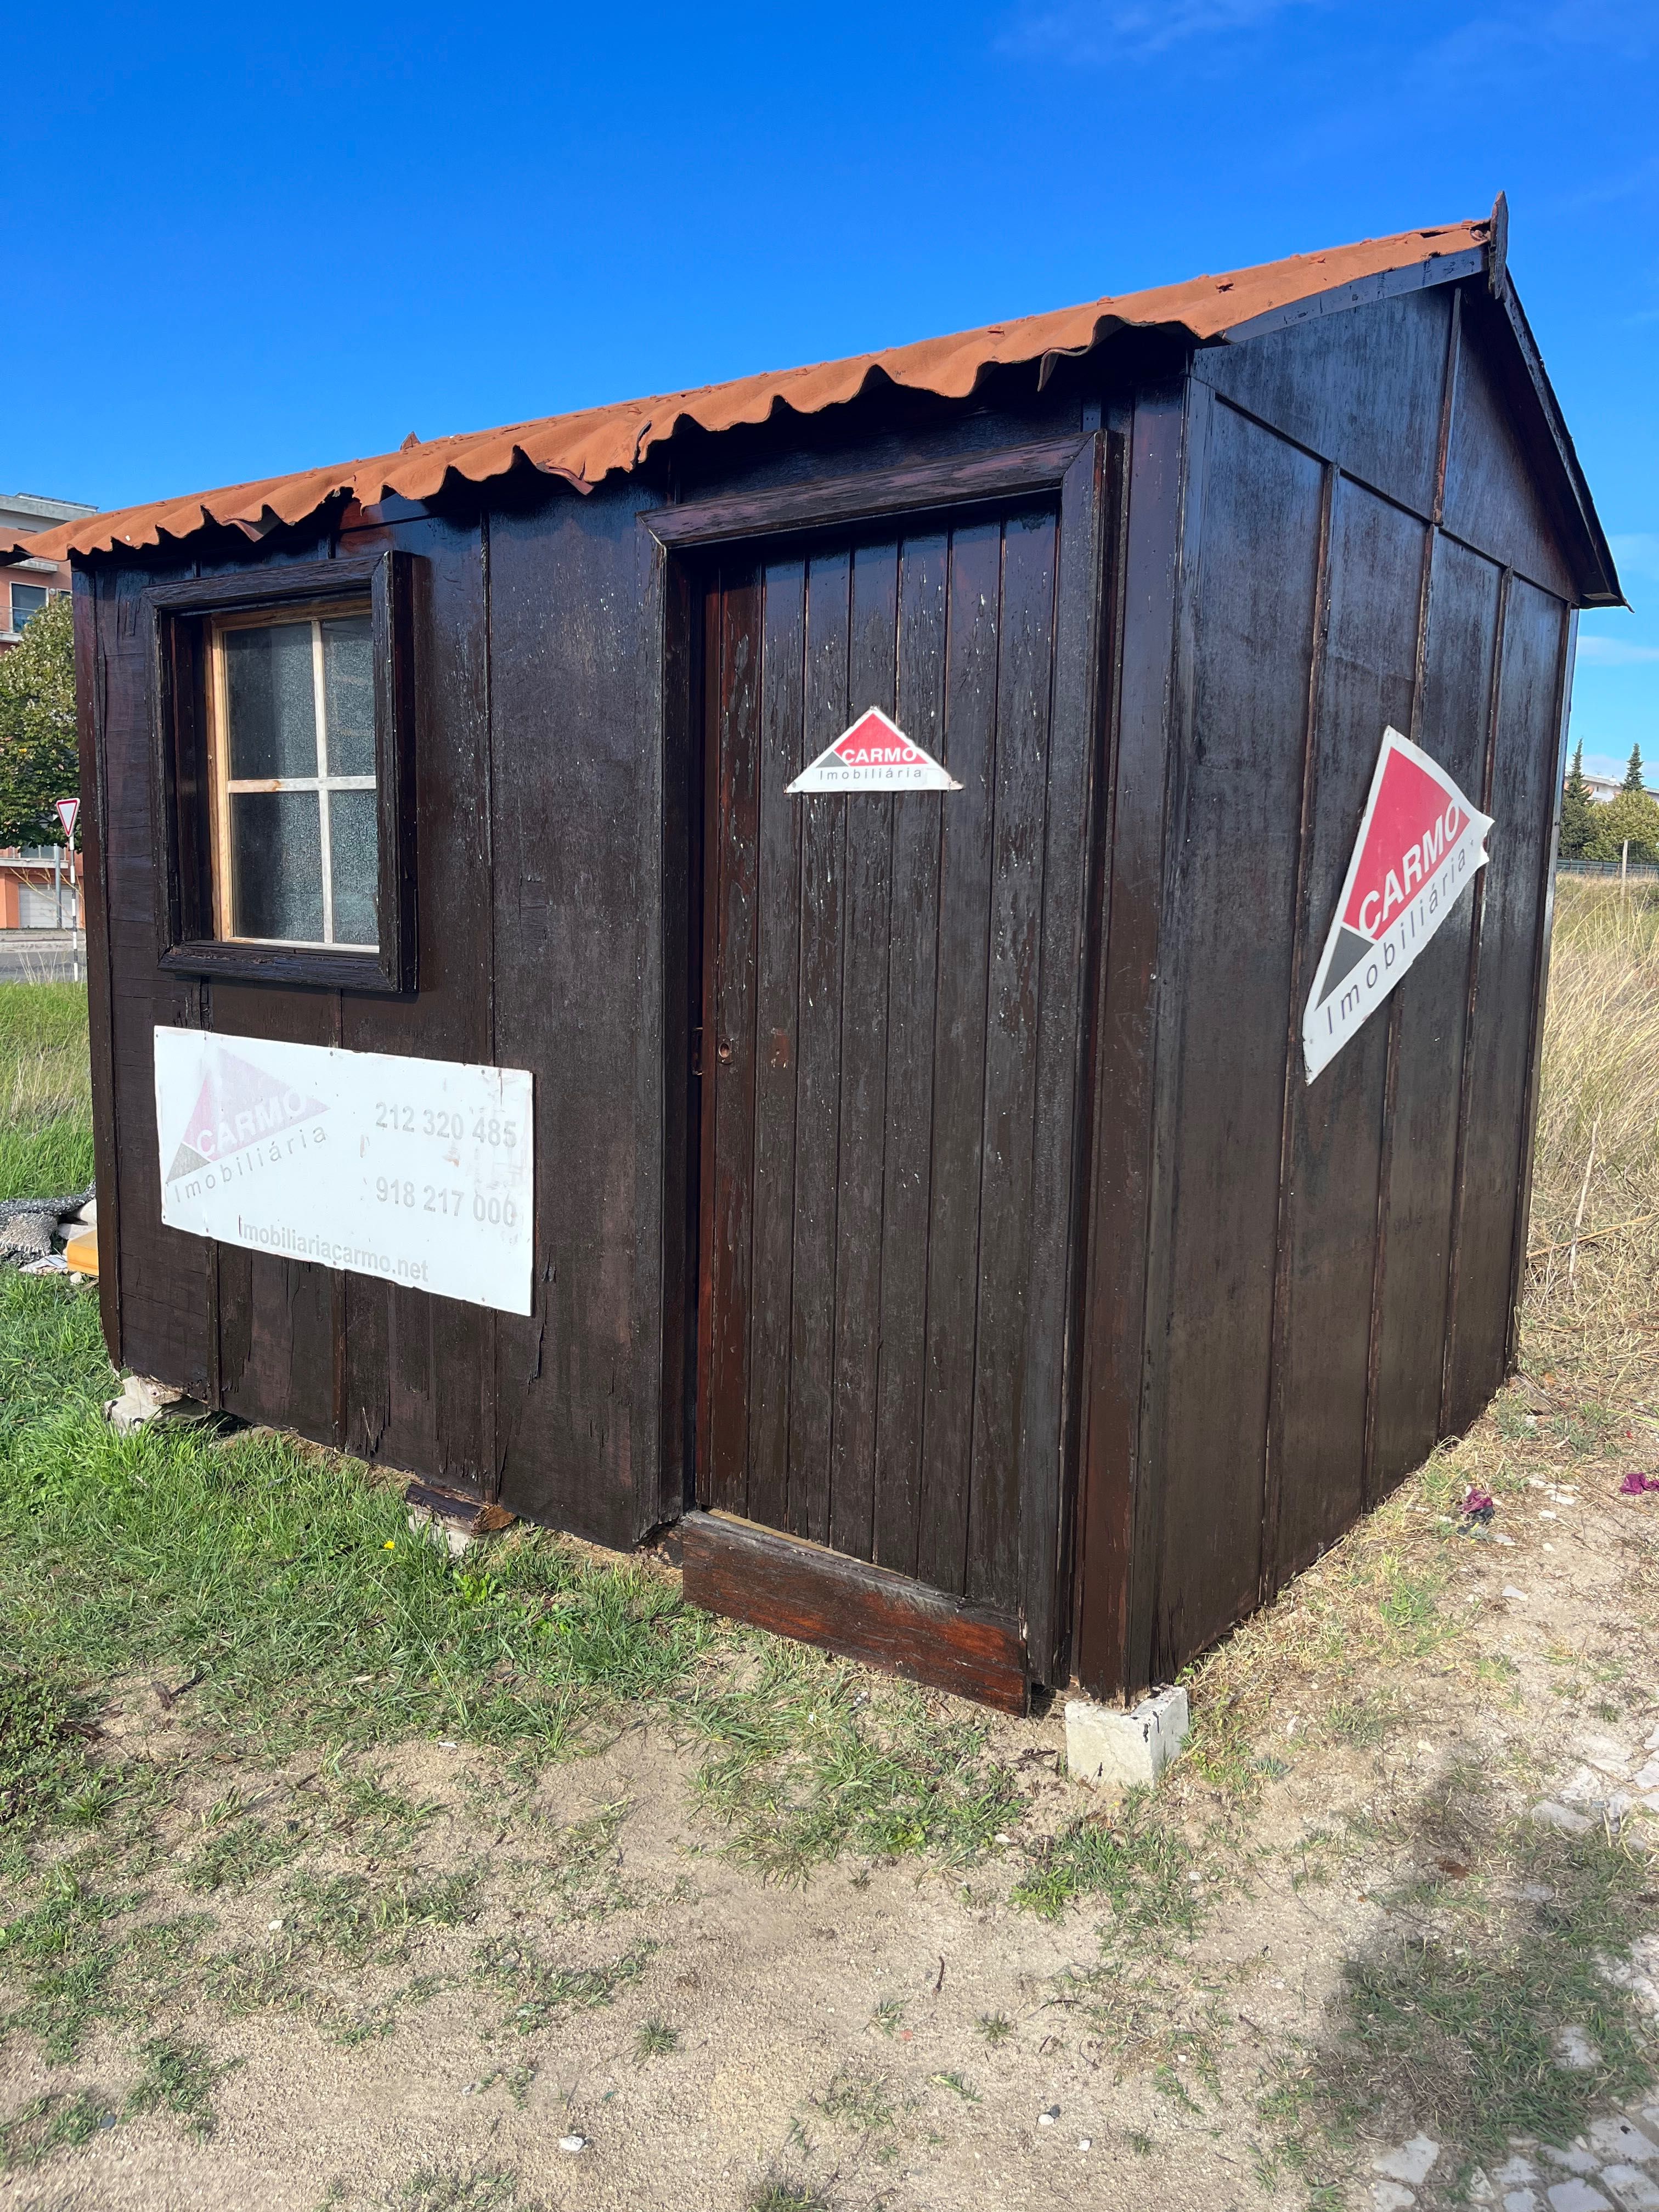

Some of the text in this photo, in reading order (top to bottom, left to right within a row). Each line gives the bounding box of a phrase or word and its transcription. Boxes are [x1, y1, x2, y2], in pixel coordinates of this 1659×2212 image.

[820, 768, 922, 780] Imobiliária
[842, 747, 917, 764] CARMO
[1359, 799, 1460, 935] CARMO
[1327, 847, 1466, 1035] Imobiliária
[197, 1087, 307, 1158] CARMO
[376, 1102, 517, 1148] 212 320 485
[174, 1126, 328, 1203] Imobiliária
[376, 1176, 415, 1207] 918
[424, 1185, 464, 1216] 217
